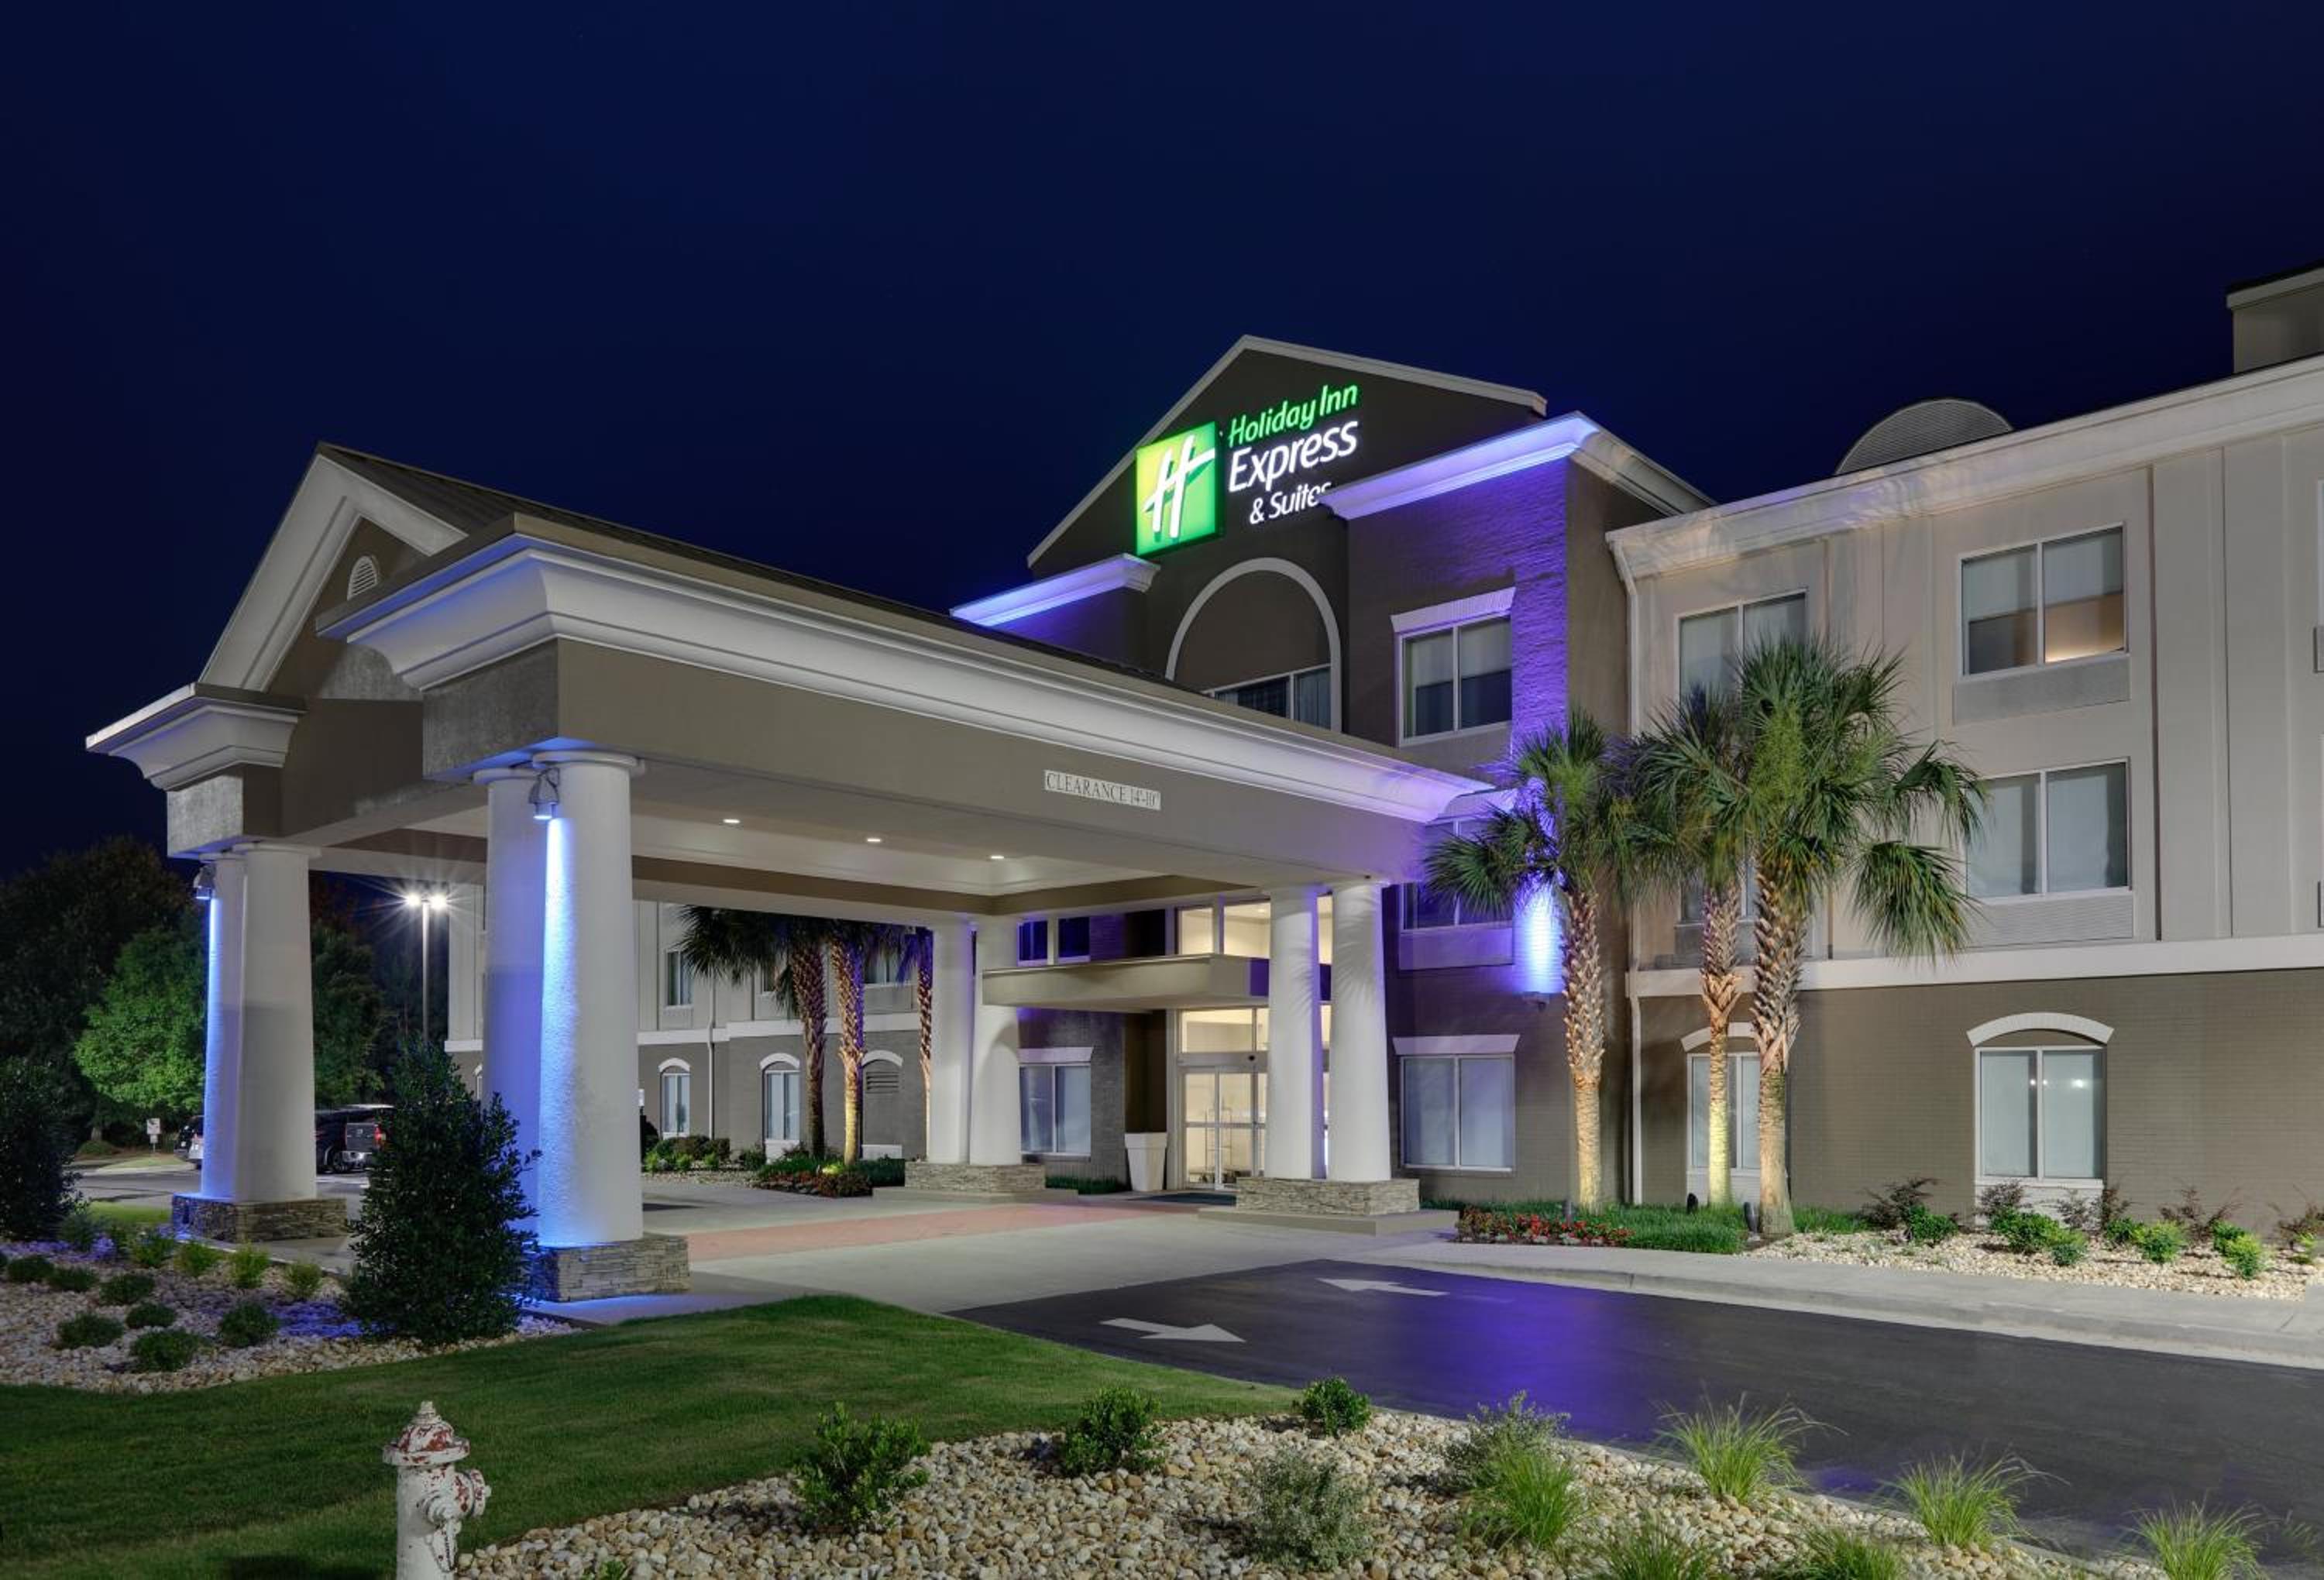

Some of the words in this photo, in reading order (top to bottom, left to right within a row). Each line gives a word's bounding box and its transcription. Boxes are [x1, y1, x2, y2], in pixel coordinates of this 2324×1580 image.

[1229, 400, 1315, 448] Holiday
[1320, 385, 1358, 416] Inn
[1229, 421, 1358, 492] Express
[1250, 497, 1264, 524] &
[1047, 772, 1128, 802] CLEARANCE
